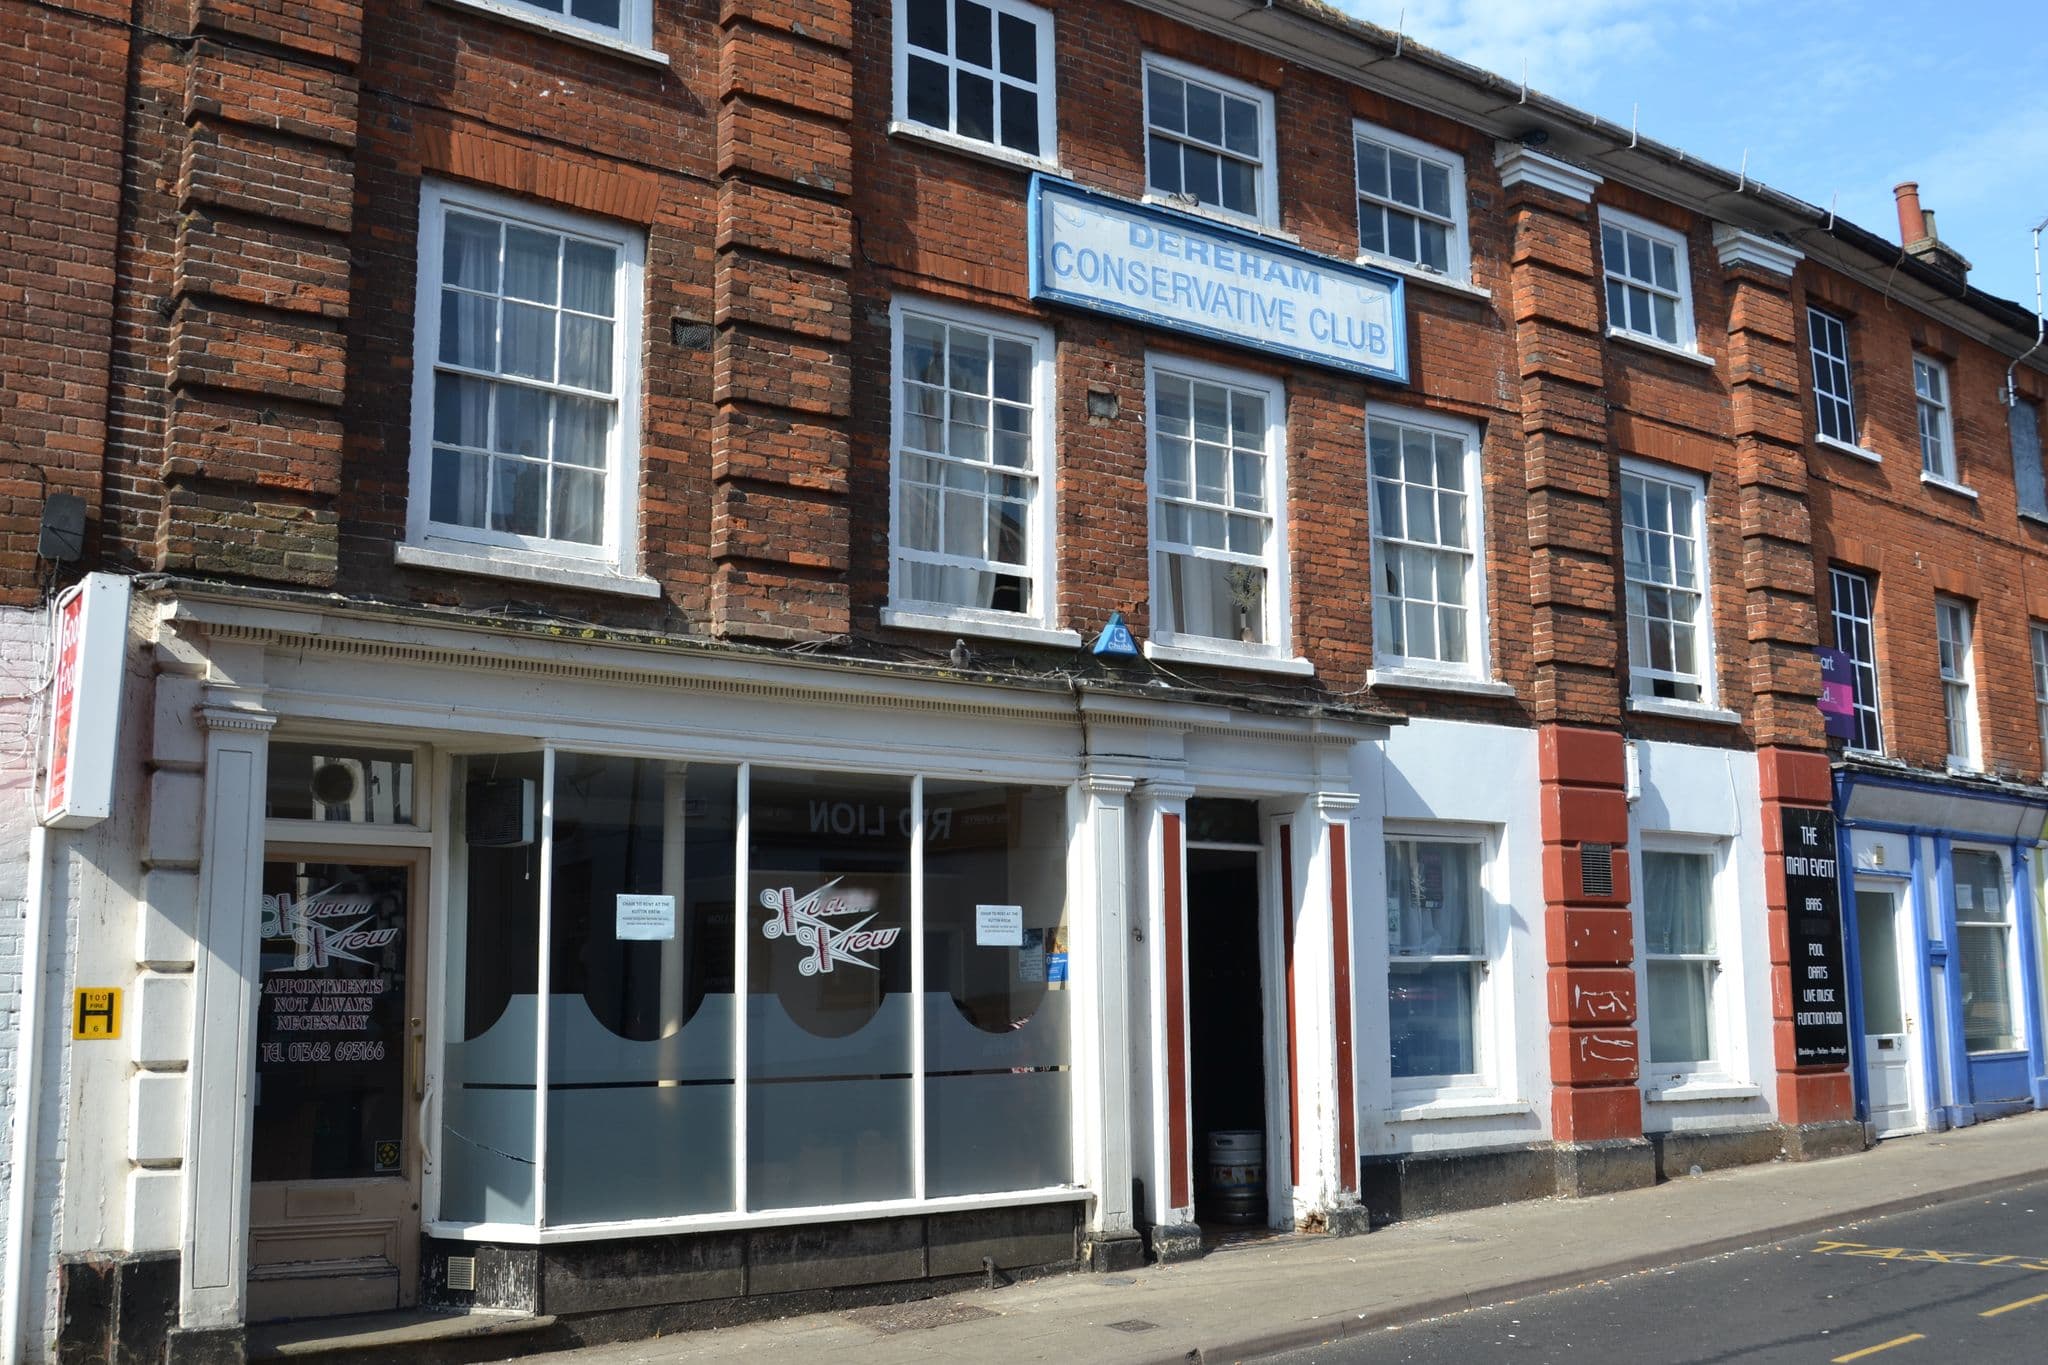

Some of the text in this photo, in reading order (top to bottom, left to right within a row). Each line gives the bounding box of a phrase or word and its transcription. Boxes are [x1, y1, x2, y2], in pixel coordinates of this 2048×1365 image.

[1129, 220, 1321, 295] DEREHAM
[1049, 240, 1387, 357] CONSERVATIVE CLUB
[1108, 642, 1133, 651] Chubb
[1800, 825, 1818, 845] THE
[1786, 856, 1835, 878] MAIN EVENT
[1805, 897, 1823, 911] BARS
[292, 914, 399, 969] Krew
[795, 912, 901, 976] Krew
[1808, 943, 1825, 956] POOL
[1807, 966, 1828, 979] DARTS
[265, 978, 384, 994] APPOINTMENTS
[1803, 989, 1835, 1002] LIVE MUSIC
[274, 997, 374, 1012] NOT ALWAYS
[79, 992, 114, 1034] H
[1797, 1012, 1843, 1025] FUNCTION ROOM
[276, 1015, 369, 1031] NECESSARY
[262, 1040, 385, 1062] TEL 01362 693166
